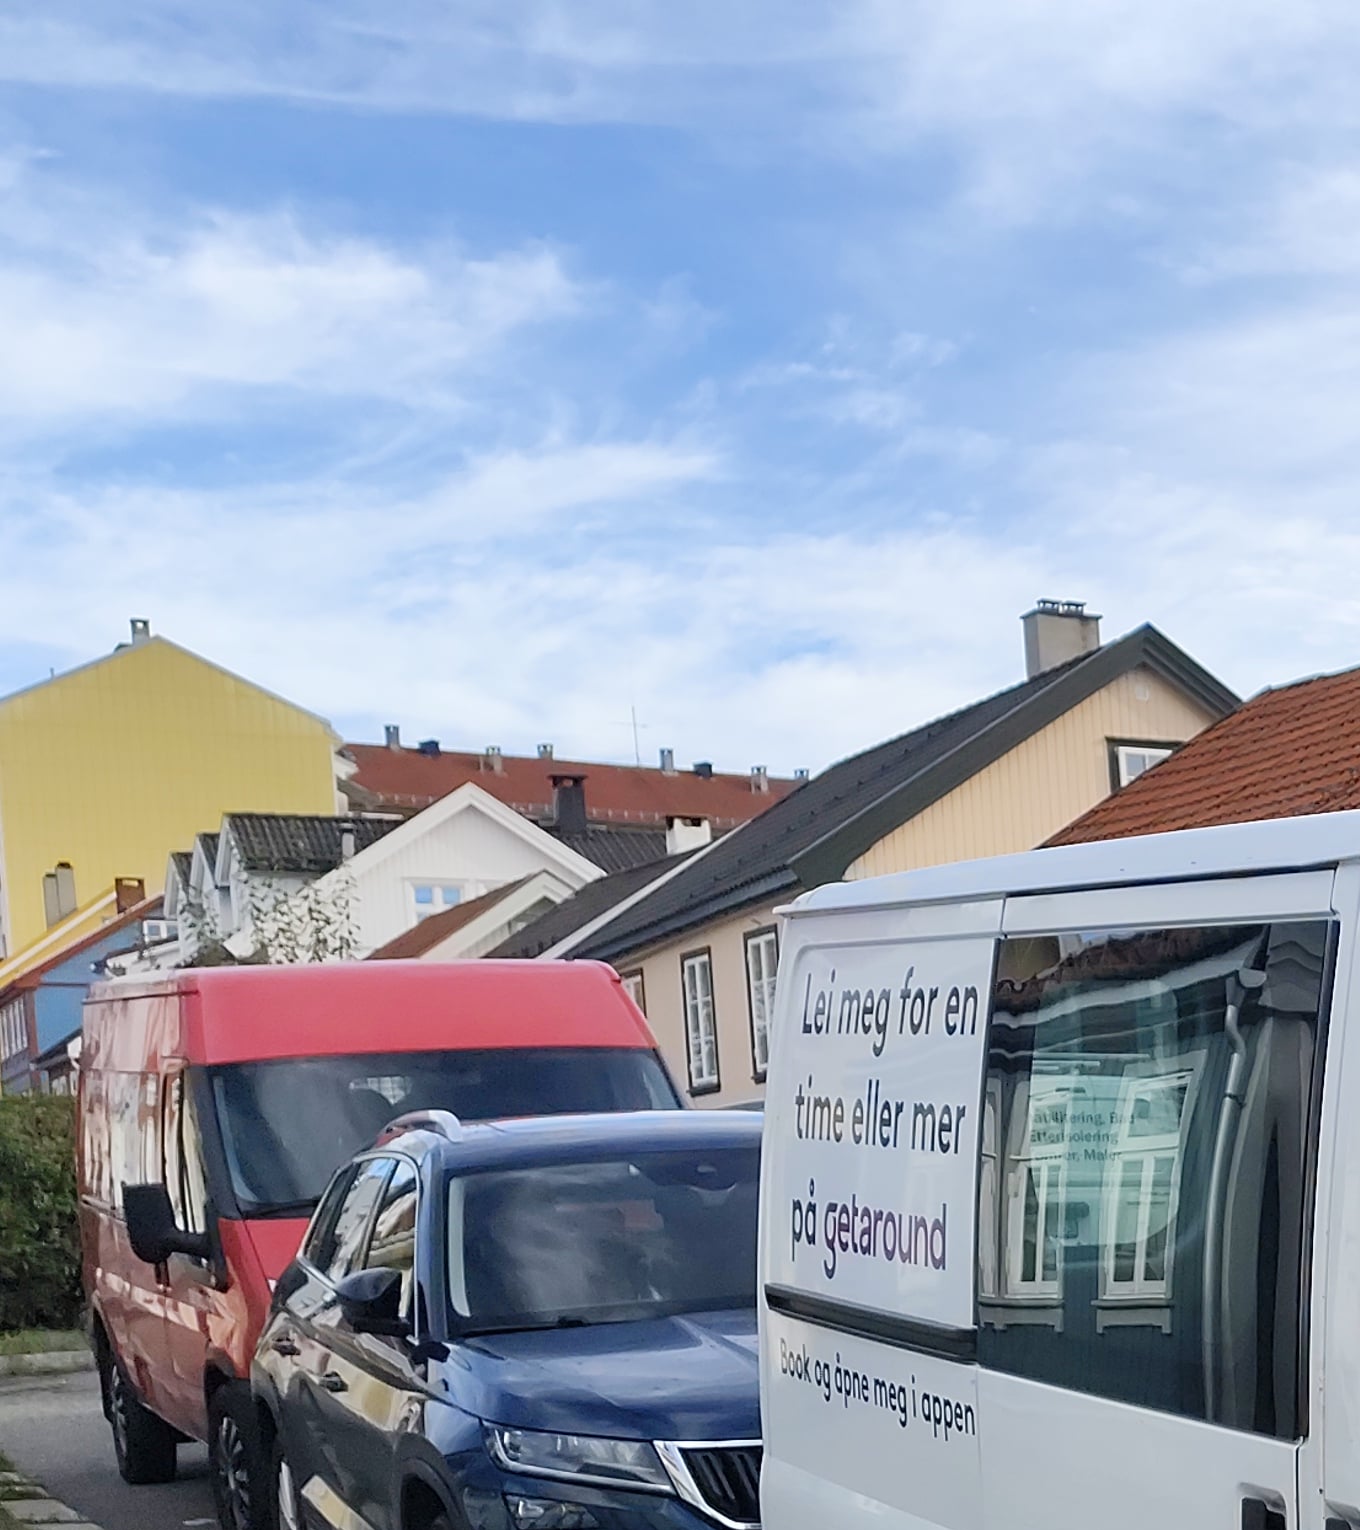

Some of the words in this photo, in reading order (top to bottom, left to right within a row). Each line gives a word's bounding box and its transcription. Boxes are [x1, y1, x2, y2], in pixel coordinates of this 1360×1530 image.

[801, 969, 836, 1036] Lei
[838, 990, 888, 1057] meg
[898, 966, 938, 1036] for
[944, 985, 977, 1037] en
[795, 1074, 844, 1143] time
[852, 1079, 904, 1149] eller
[911, 1100, 966, 1155] mer
[791, 1178, 816, 1261] på
[823, 1194, 947, 1278] getaround
[779, 1337, 812, 1384] Book
[814, 1357, 832, 1402] og
[834, 1352, 869, 1405] åpne
[873, 1377, 907, 1428] meg
[910, 1375, 917, 1413] i
[921, 1395, 976, 1441] appen
